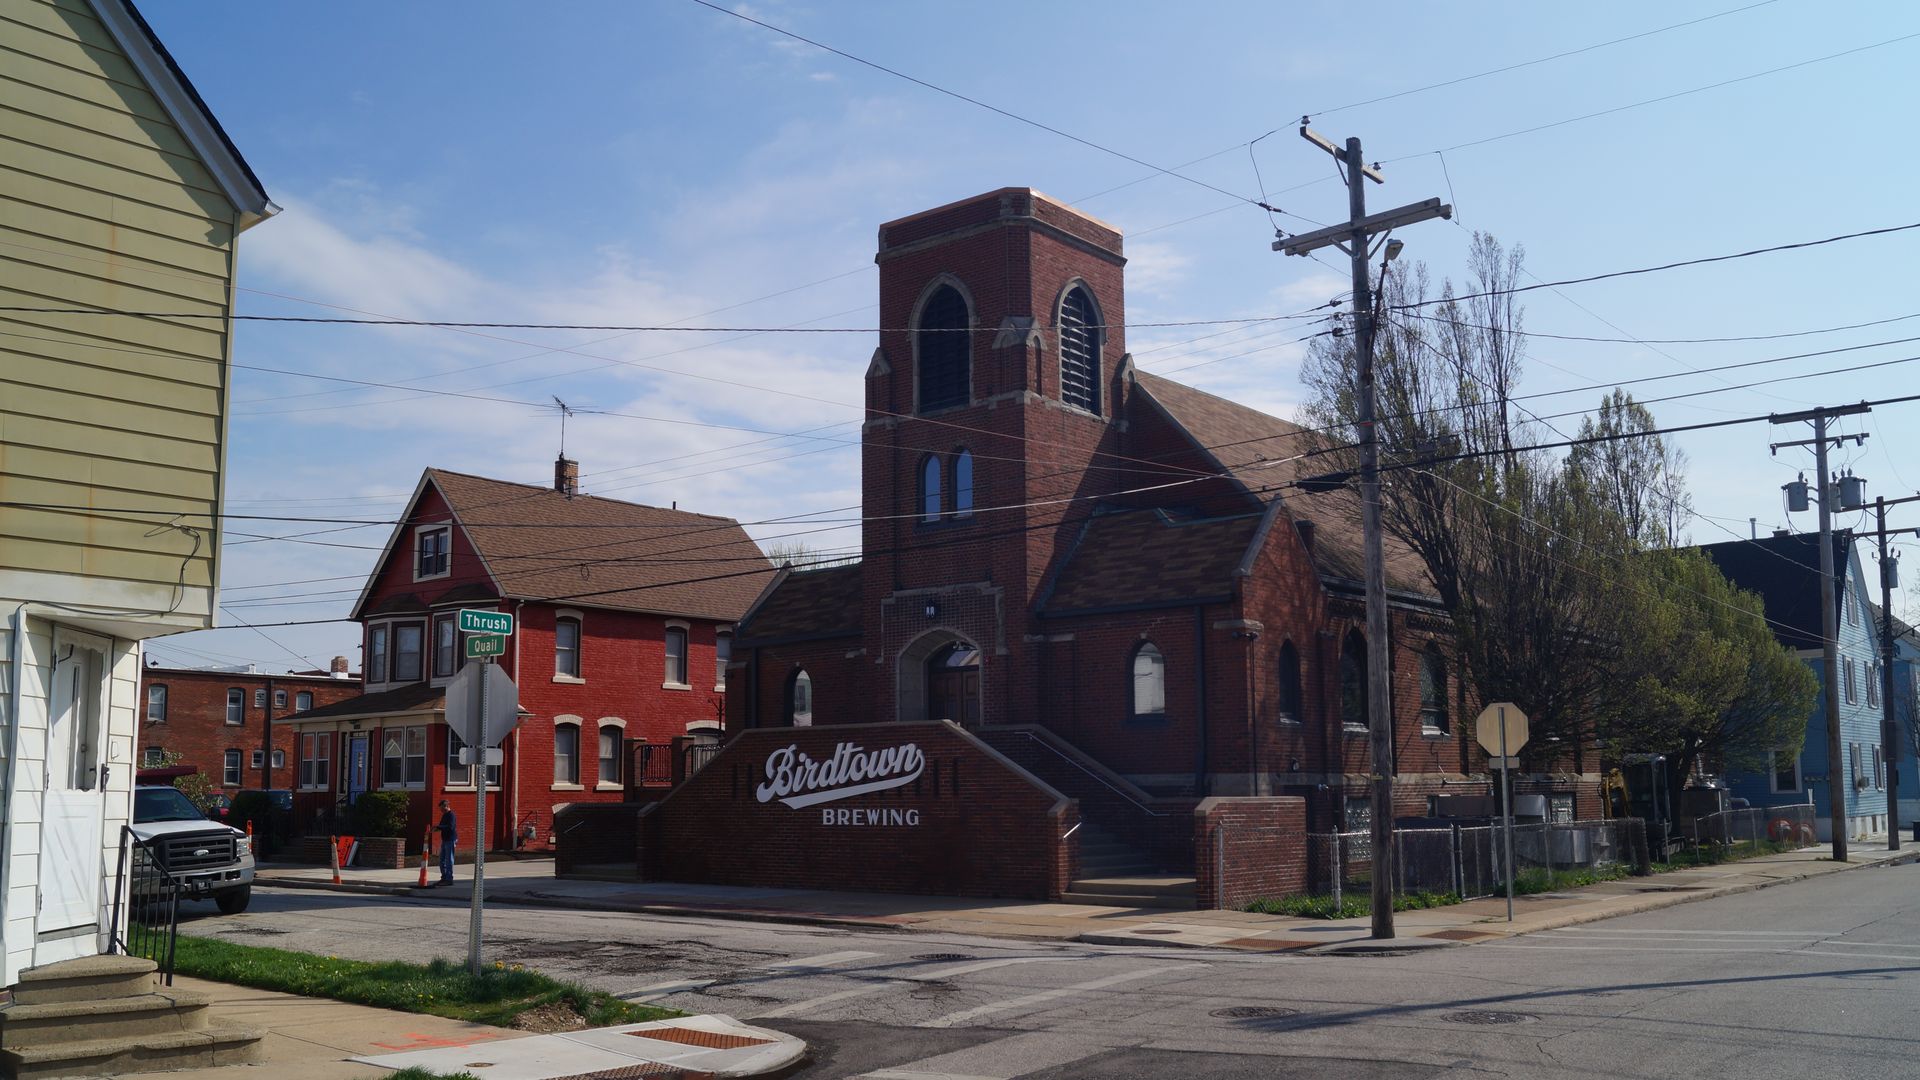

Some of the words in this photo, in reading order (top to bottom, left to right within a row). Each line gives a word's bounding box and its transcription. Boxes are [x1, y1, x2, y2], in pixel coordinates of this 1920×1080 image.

[465, 614, 508, 630] Thrush
[474, 639, 498, 653] Quail
[756, 742, 926, 803] Birdtown
[822, 808, 920, 826] BREWING
